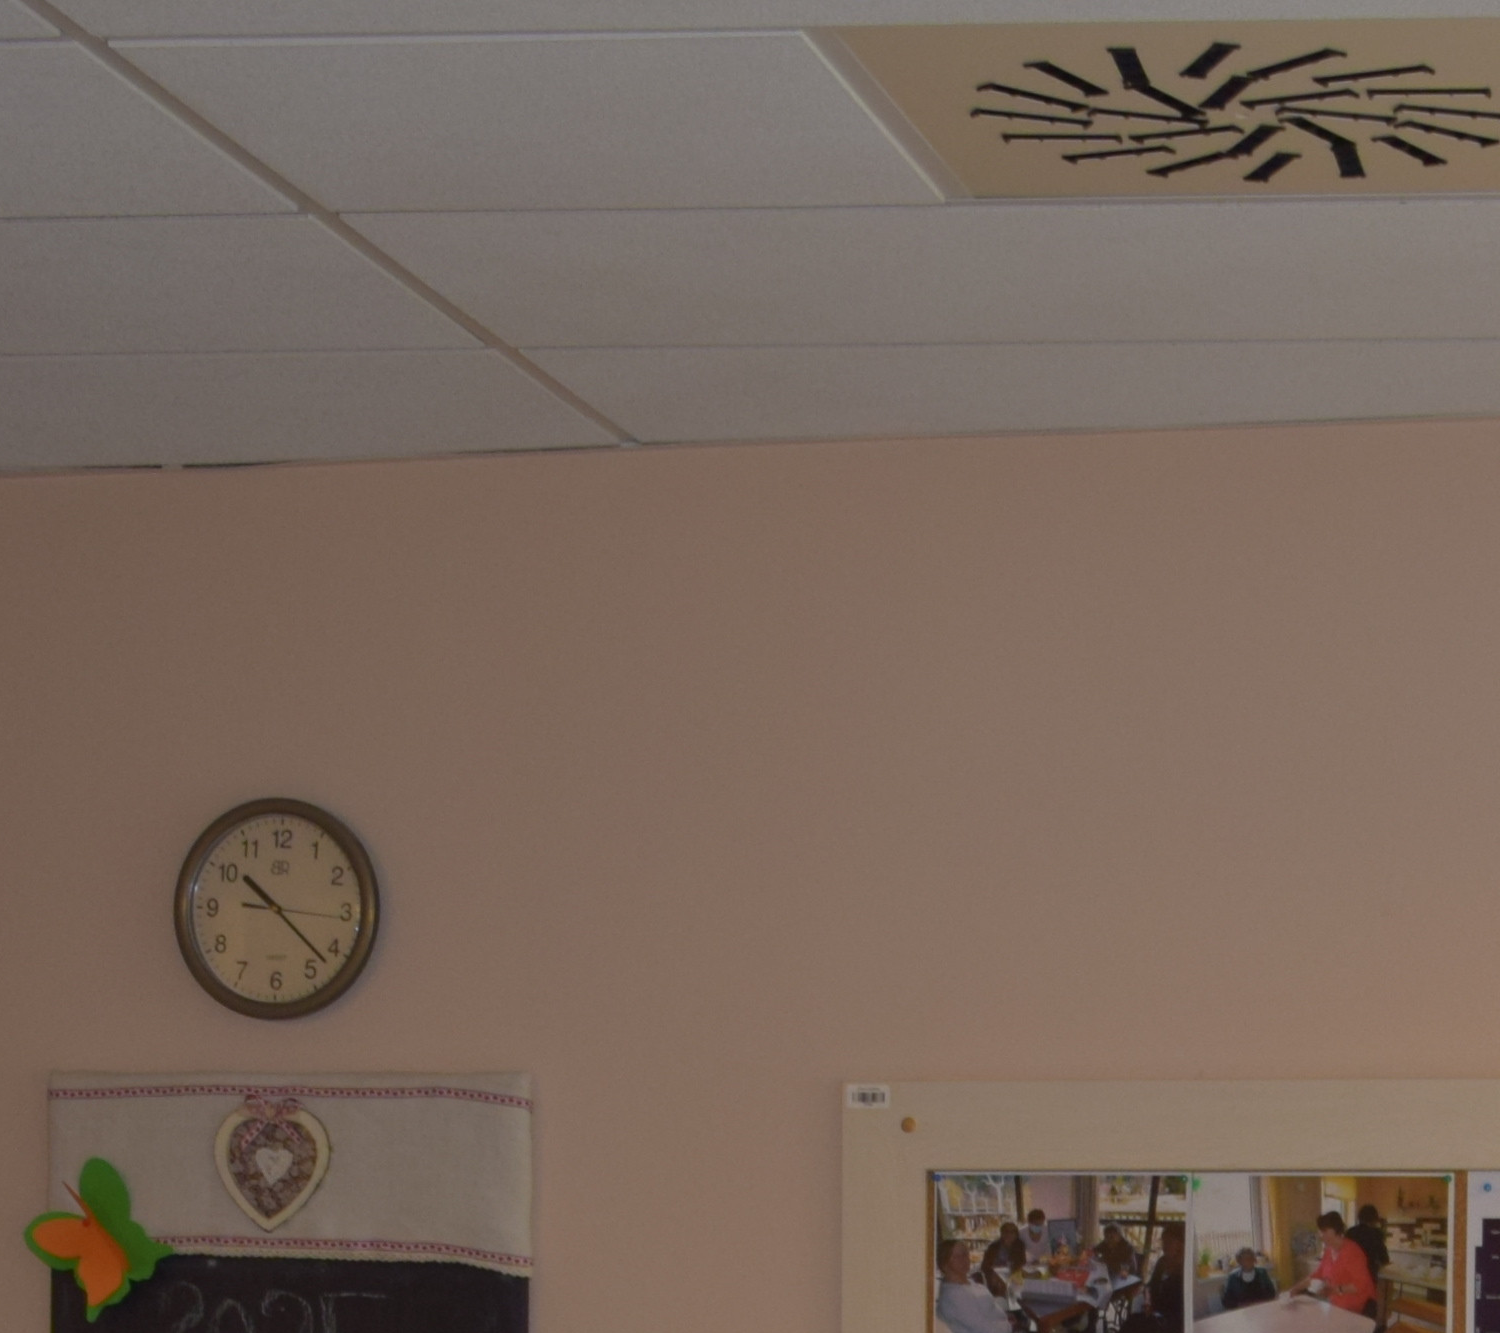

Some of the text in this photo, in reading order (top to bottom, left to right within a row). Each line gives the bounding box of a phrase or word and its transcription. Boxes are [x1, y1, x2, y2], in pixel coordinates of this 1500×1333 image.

[273, 830, 292, 848] 12
[242, 840, 259, 858] 11
[312, 841, 319, 859] 1
[220, 864, 237, 882] 10
[332, 867, 343, 886] 2
[207, 899, 218, 917] 9
[341, 904, 351, 922] 3
[215, 935, 227, 953] 8
[328, 939, 339, 956] 4
[237, 962, 247, 980] 7
[305, 960, 317, 979] 5
[271, 972, 282, 990] 6
